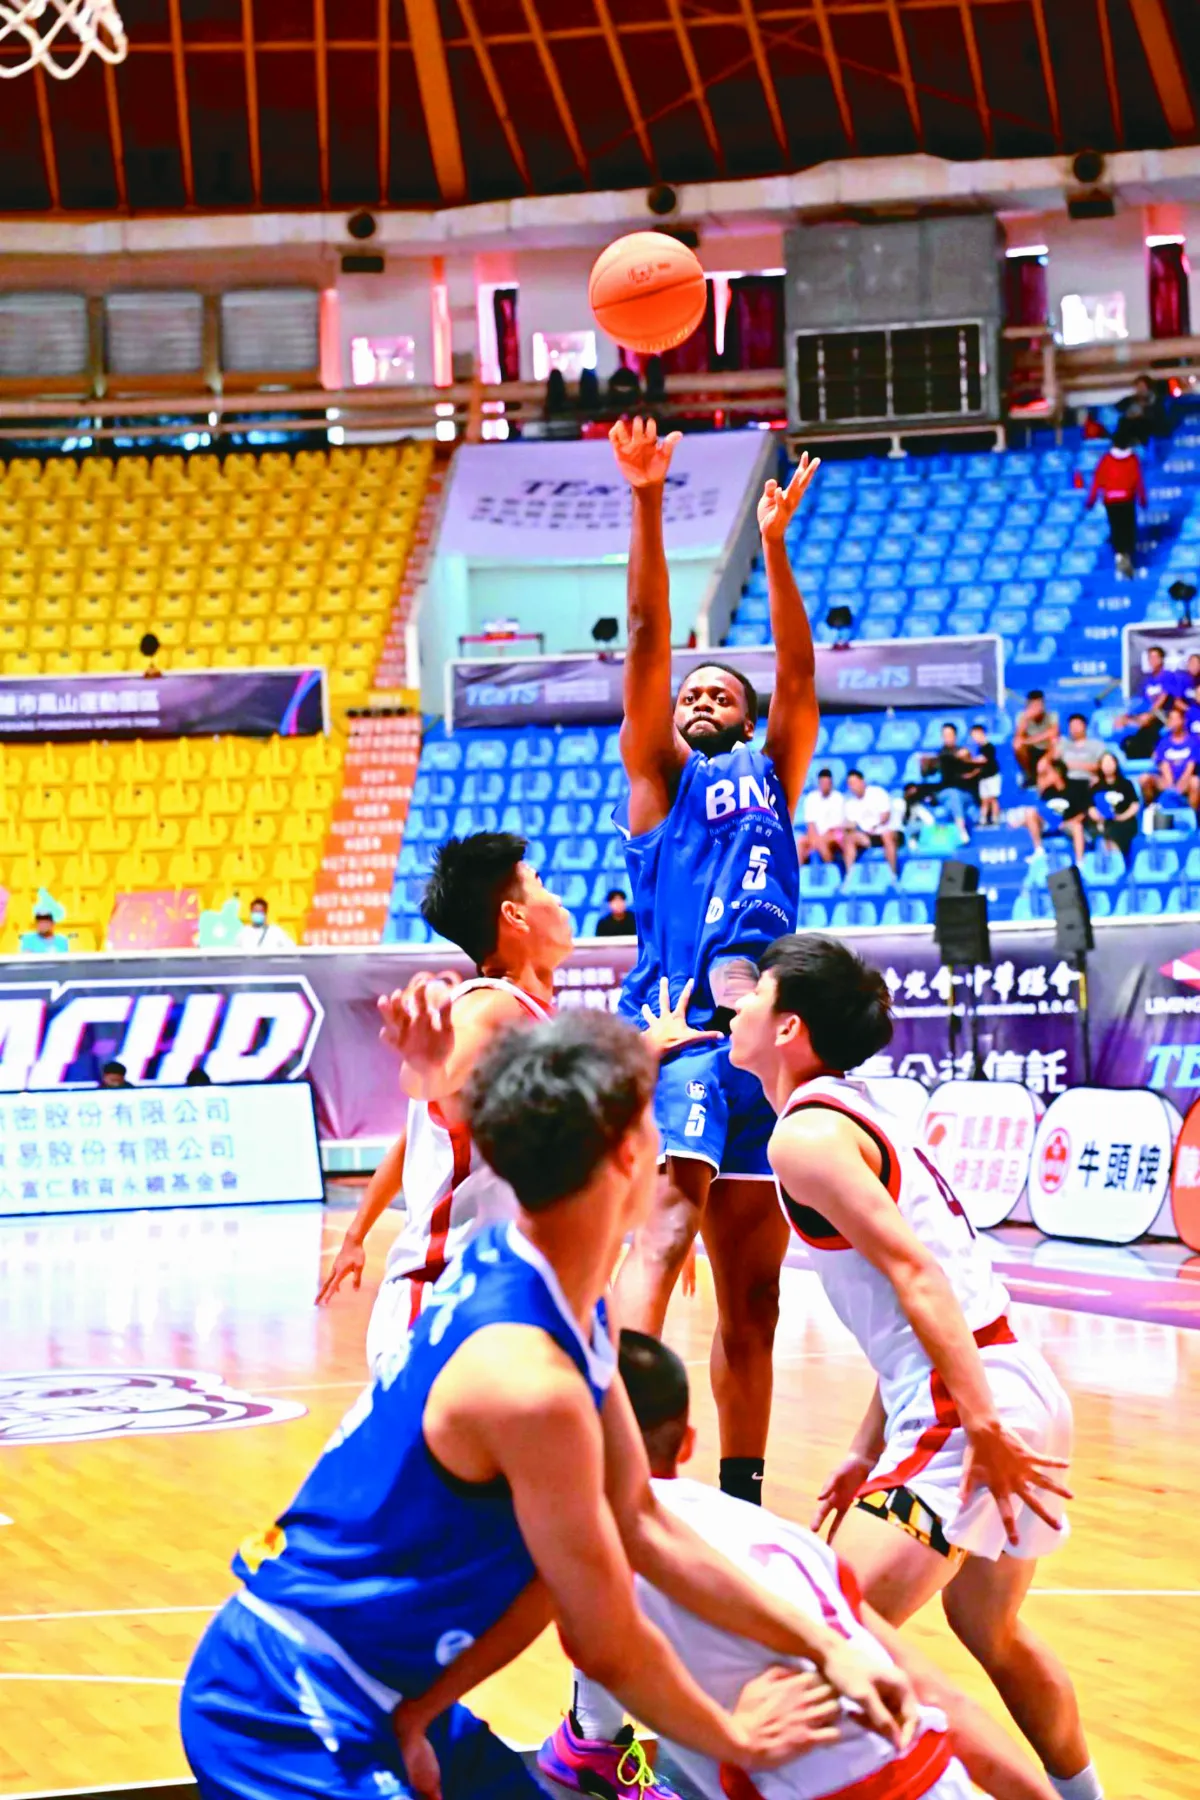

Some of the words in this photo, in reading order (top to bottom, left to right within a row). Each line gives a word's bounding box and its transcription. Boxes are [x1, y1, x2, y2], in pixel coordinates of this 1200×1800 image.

[742, 844, 771, 890] 5
[0, 1097, 230, 1131] 密股份有限公司
[684, 1103, 707, 1137] 5
[0, 1135, 235, 1169] 易股份有限公司
[1077, 1140, 1161, 1193] 牛頭牌
